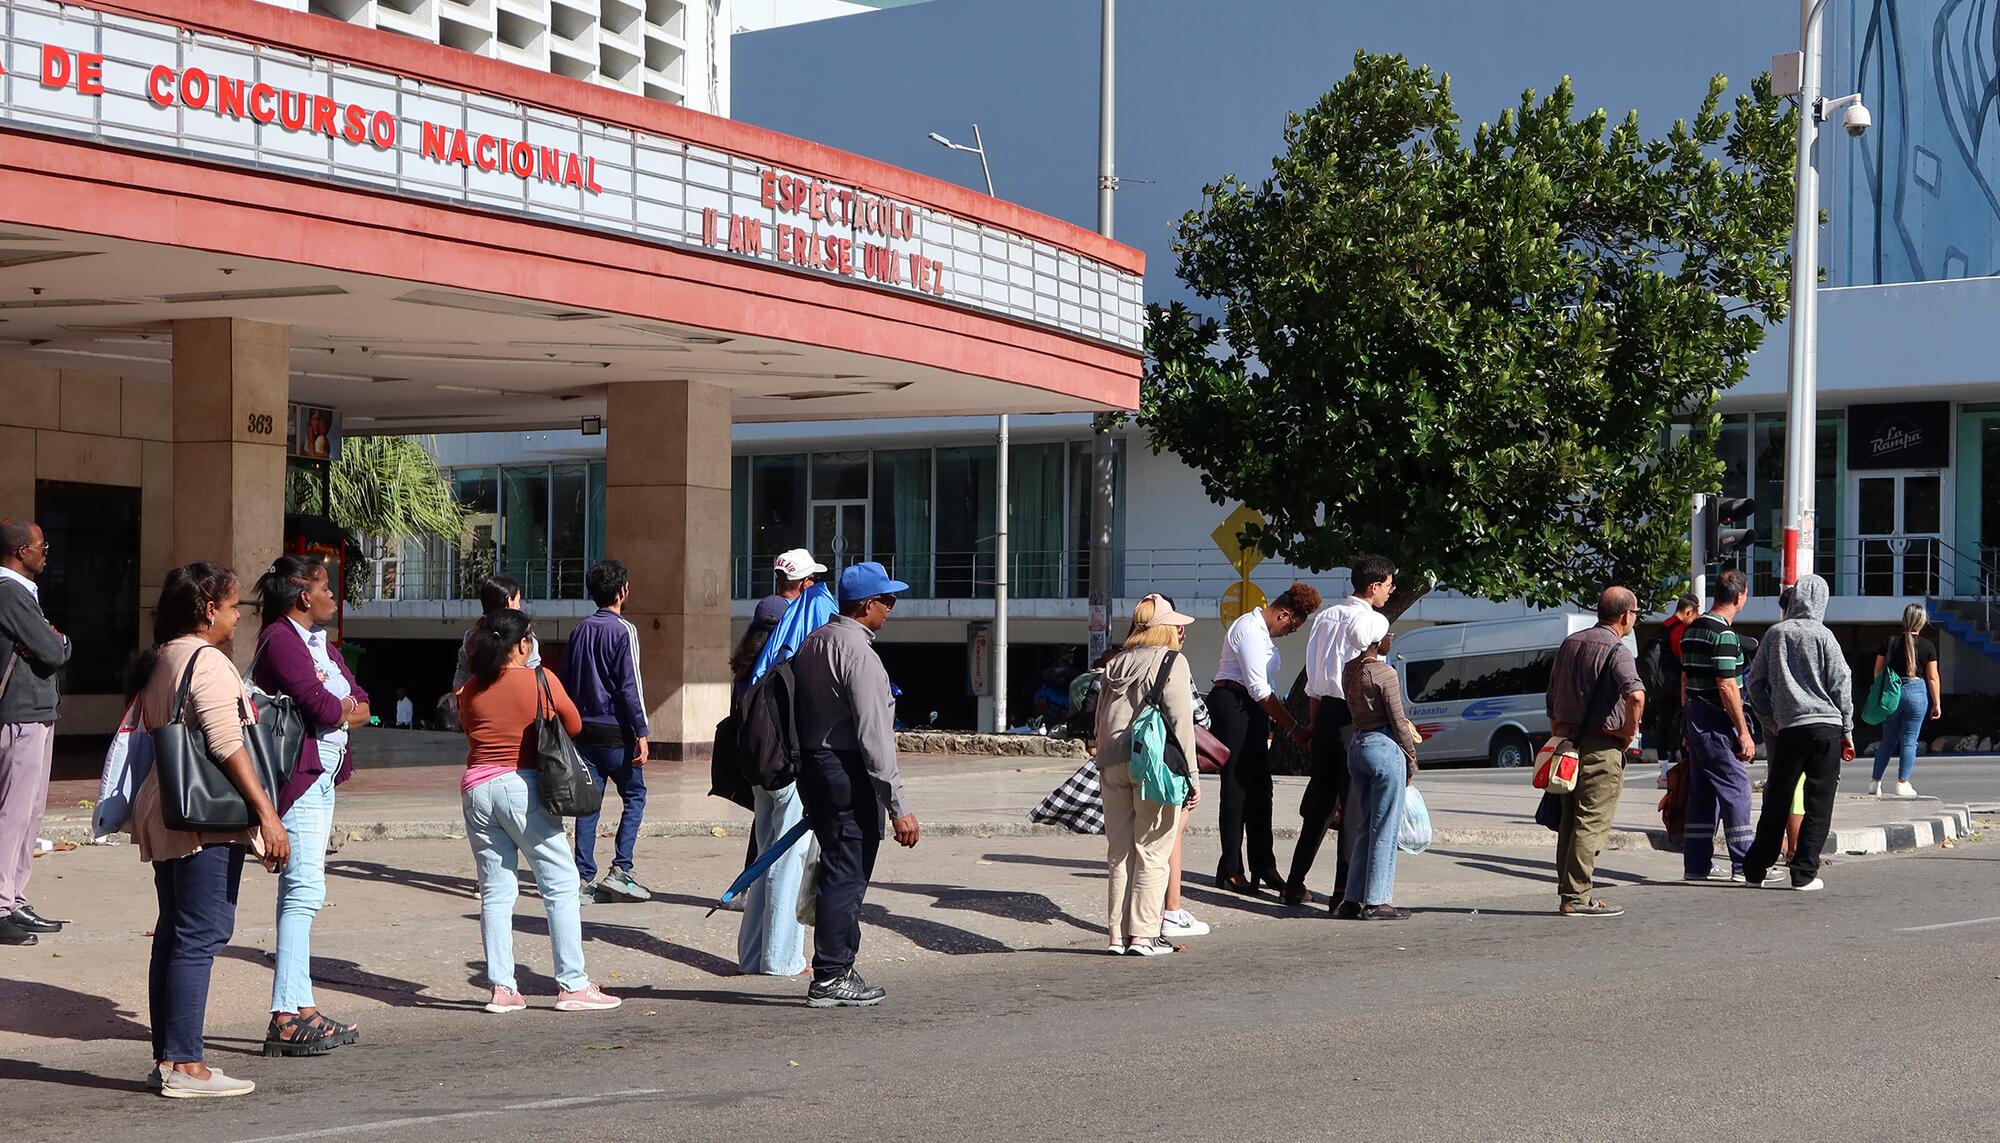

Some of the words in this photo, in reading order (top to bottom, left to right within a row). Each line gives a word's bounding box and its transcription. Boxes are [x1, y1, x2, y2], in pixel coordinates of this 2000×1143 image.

[41, 43, 104, 95] DE
[147, 64, 396, 149] CONCURSO
[421, 120, 603, 194] NACIONAL
[761, 169, 914, 241] ESPECTACULO
[729, 213, 763, 256] AM
[777, 223, 853, 275] ERASE
[864, 242, 901, 285] UNA
[909, 253, 945, 296] VEZ
[247, 413, 273, 435] 363
[1870, 432, 1922, 453] Rampa
[1885, 426, 1904, 441] La
